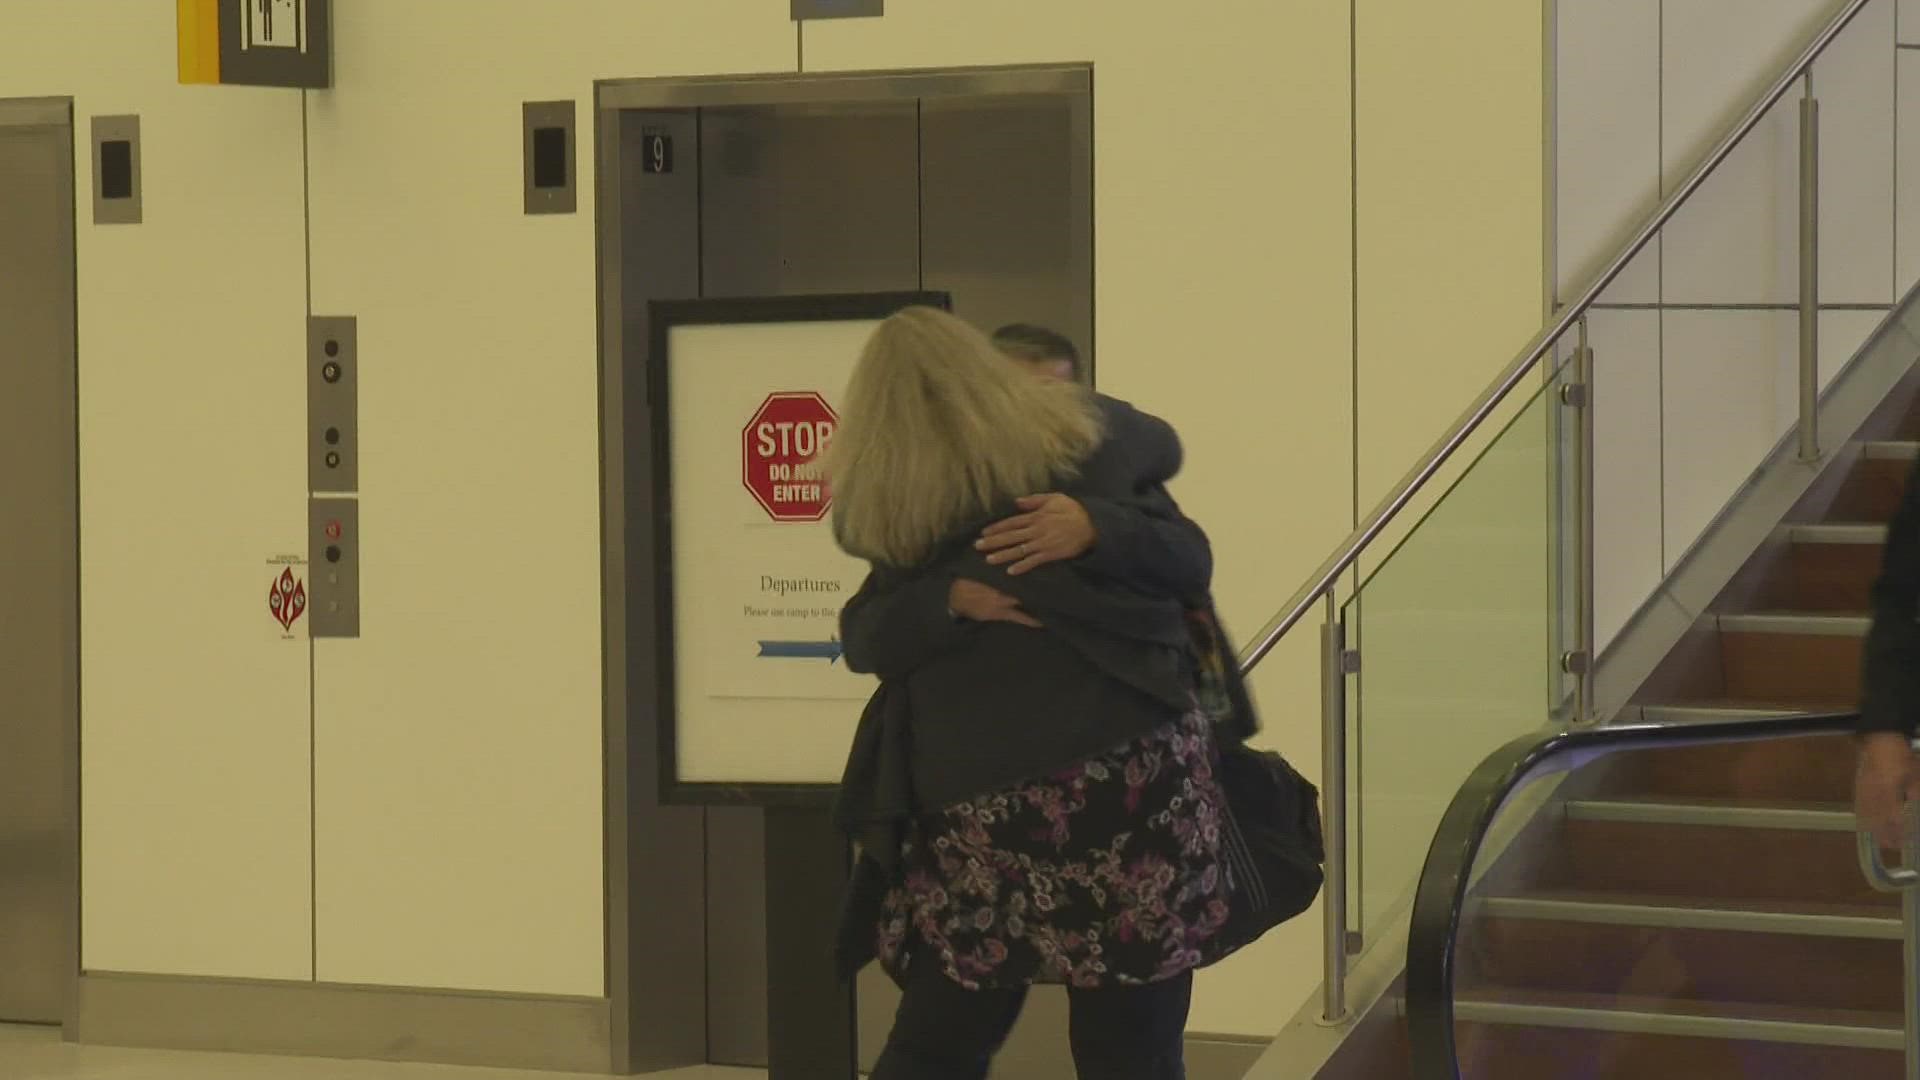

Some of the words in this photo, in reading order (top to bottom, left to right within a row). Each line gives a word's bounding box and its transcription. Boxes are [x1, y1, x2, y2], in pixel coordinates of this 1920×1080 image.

[653, 136, 664, 173] 9
[757, 421, 833, 457] STOP
[769, 464, 790, 481] DO
[773, 485, 821, 502] ENTER
[760, 575, 841, 597] Departures
[744, 604, 769, 617] Please
[786, 607, 809, 619] ramp
[811, 607, 820, 617] to
